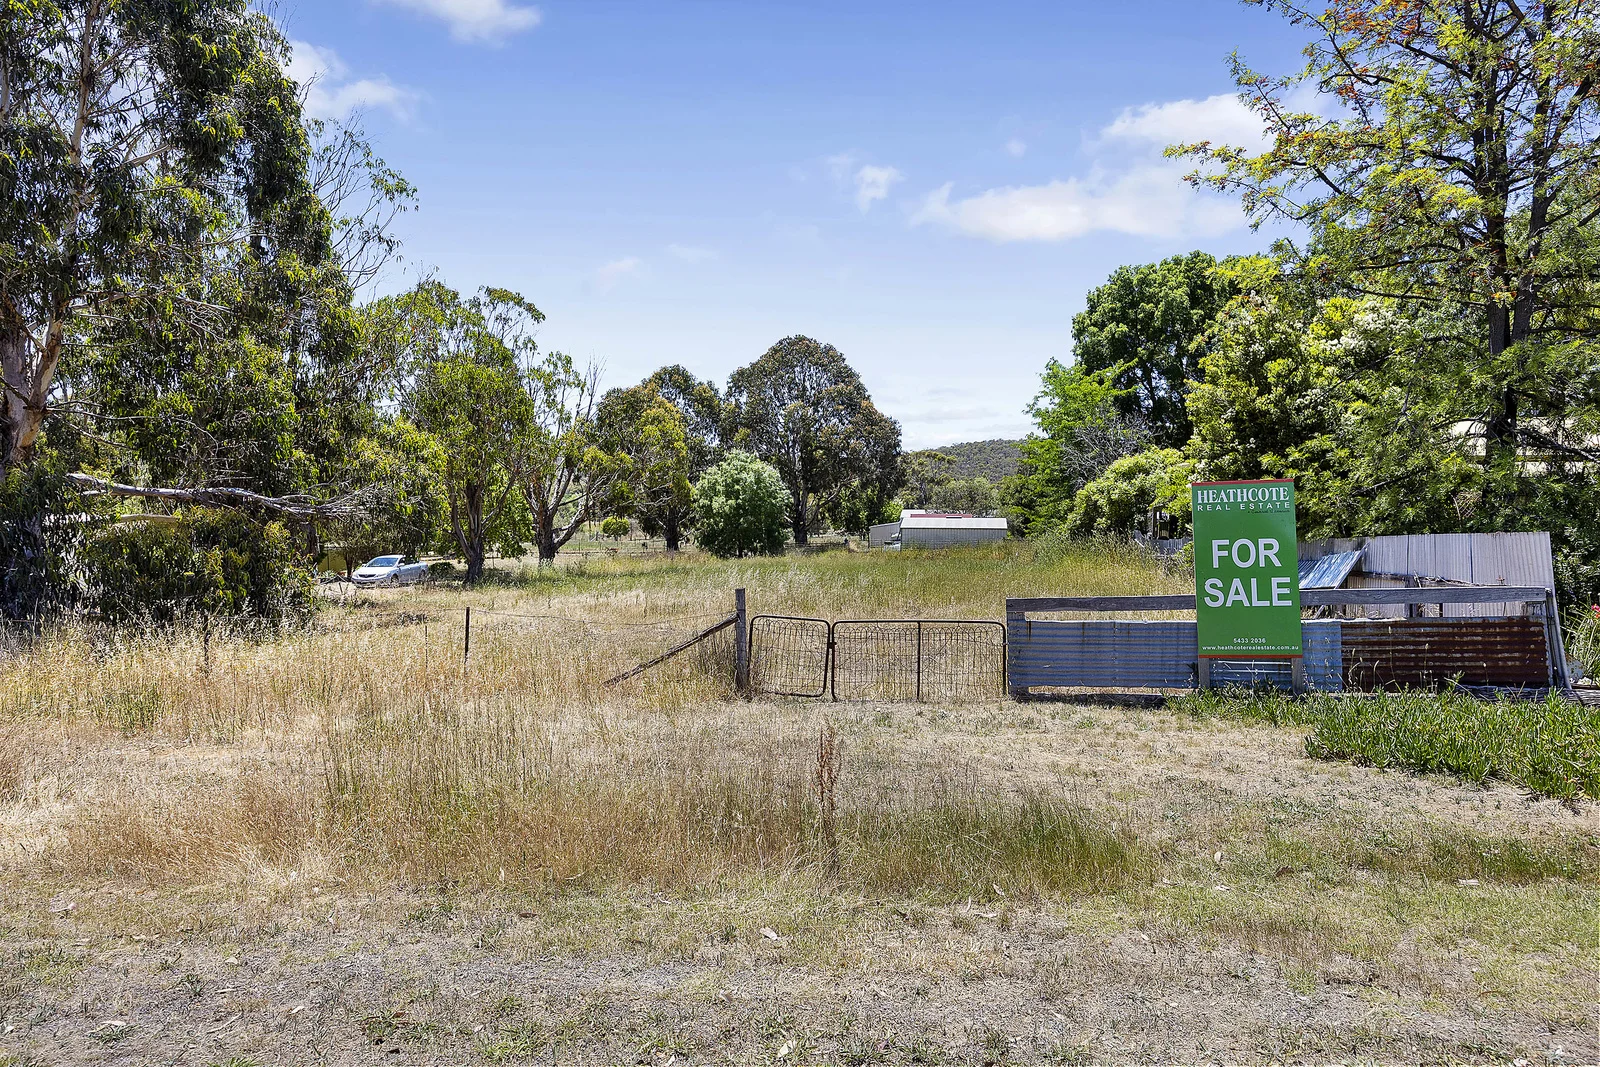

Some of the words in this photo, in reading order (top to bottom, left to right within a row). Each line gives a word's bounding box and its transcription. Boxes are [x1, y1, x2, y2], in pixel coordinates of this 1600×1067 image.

[1197, 487, 1290, 503] HEATHCOTE
[1240, 502, 1290, 510] ESTATE
[1211, 538, 1282, 568] FOR
[1204, 577, 1292, 607] SALE
